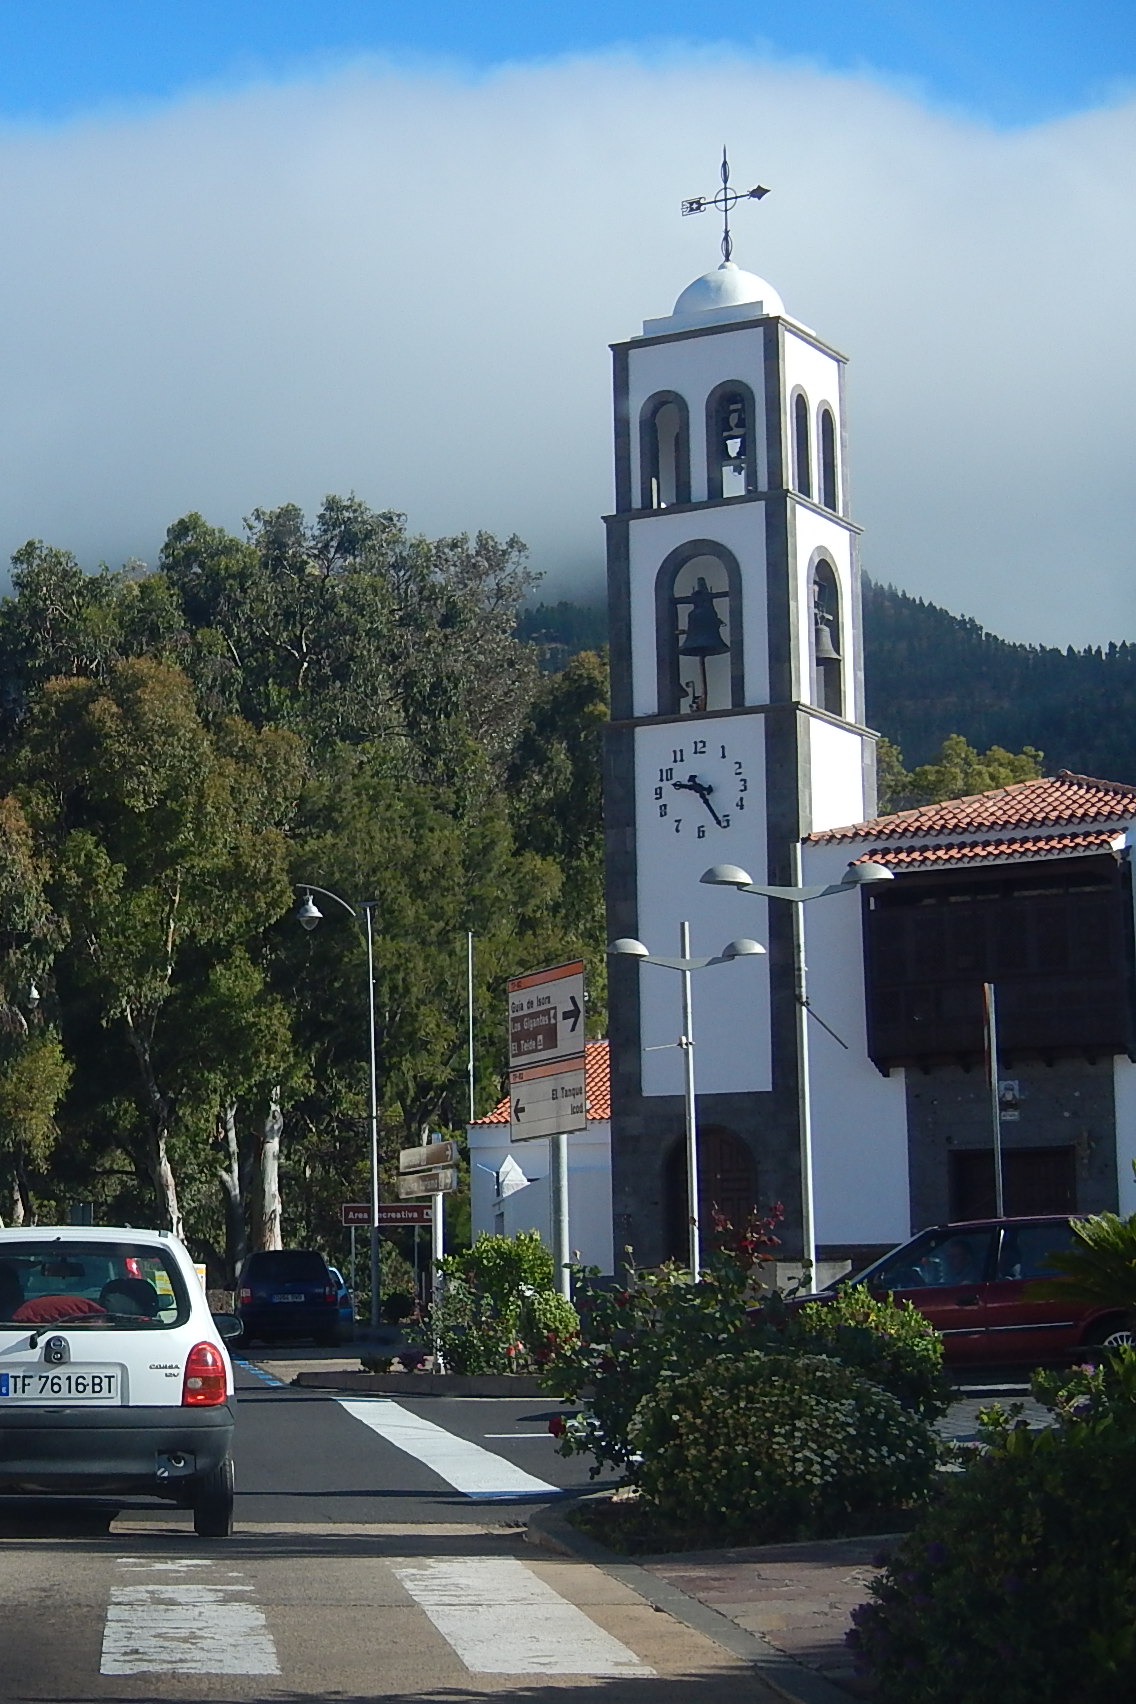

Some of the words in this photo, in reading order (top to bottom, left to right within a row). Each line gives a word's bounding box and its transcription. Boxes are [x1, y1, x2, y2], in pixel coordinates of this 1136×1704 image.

[693, 740, 706, 754] 12
[721, 745, 726, 759] 1
[673, 749, 684, 763] 11
[659, 768, 673, 782] 10
[734, 762, 742, 775] 2
[739, 779, 747, 792] 3
[655, 786, 662, 800] 9
[659, 804, 667, 817] 8
[736, 797, 744, 810] 4
[674, 819, 682, 833] 7
[722, 814, 730, 828] 5
[697, 825, 705, 838] 6
[527, 999, 534, 1009] de
[537, 995, 551, 1007] Isora
[512, 1022, 521, 1032] Los
[524, 1013, 549, 1030] Gigantes
[521, 1038, 536, 1051] Teide
[561, 1086, 583, 1099] Tanque
[571, 1103, 583, 1115] Icod
[376, 1211, 418, 1219] ecreativa
[10, 1375, 34, 1394] TF
